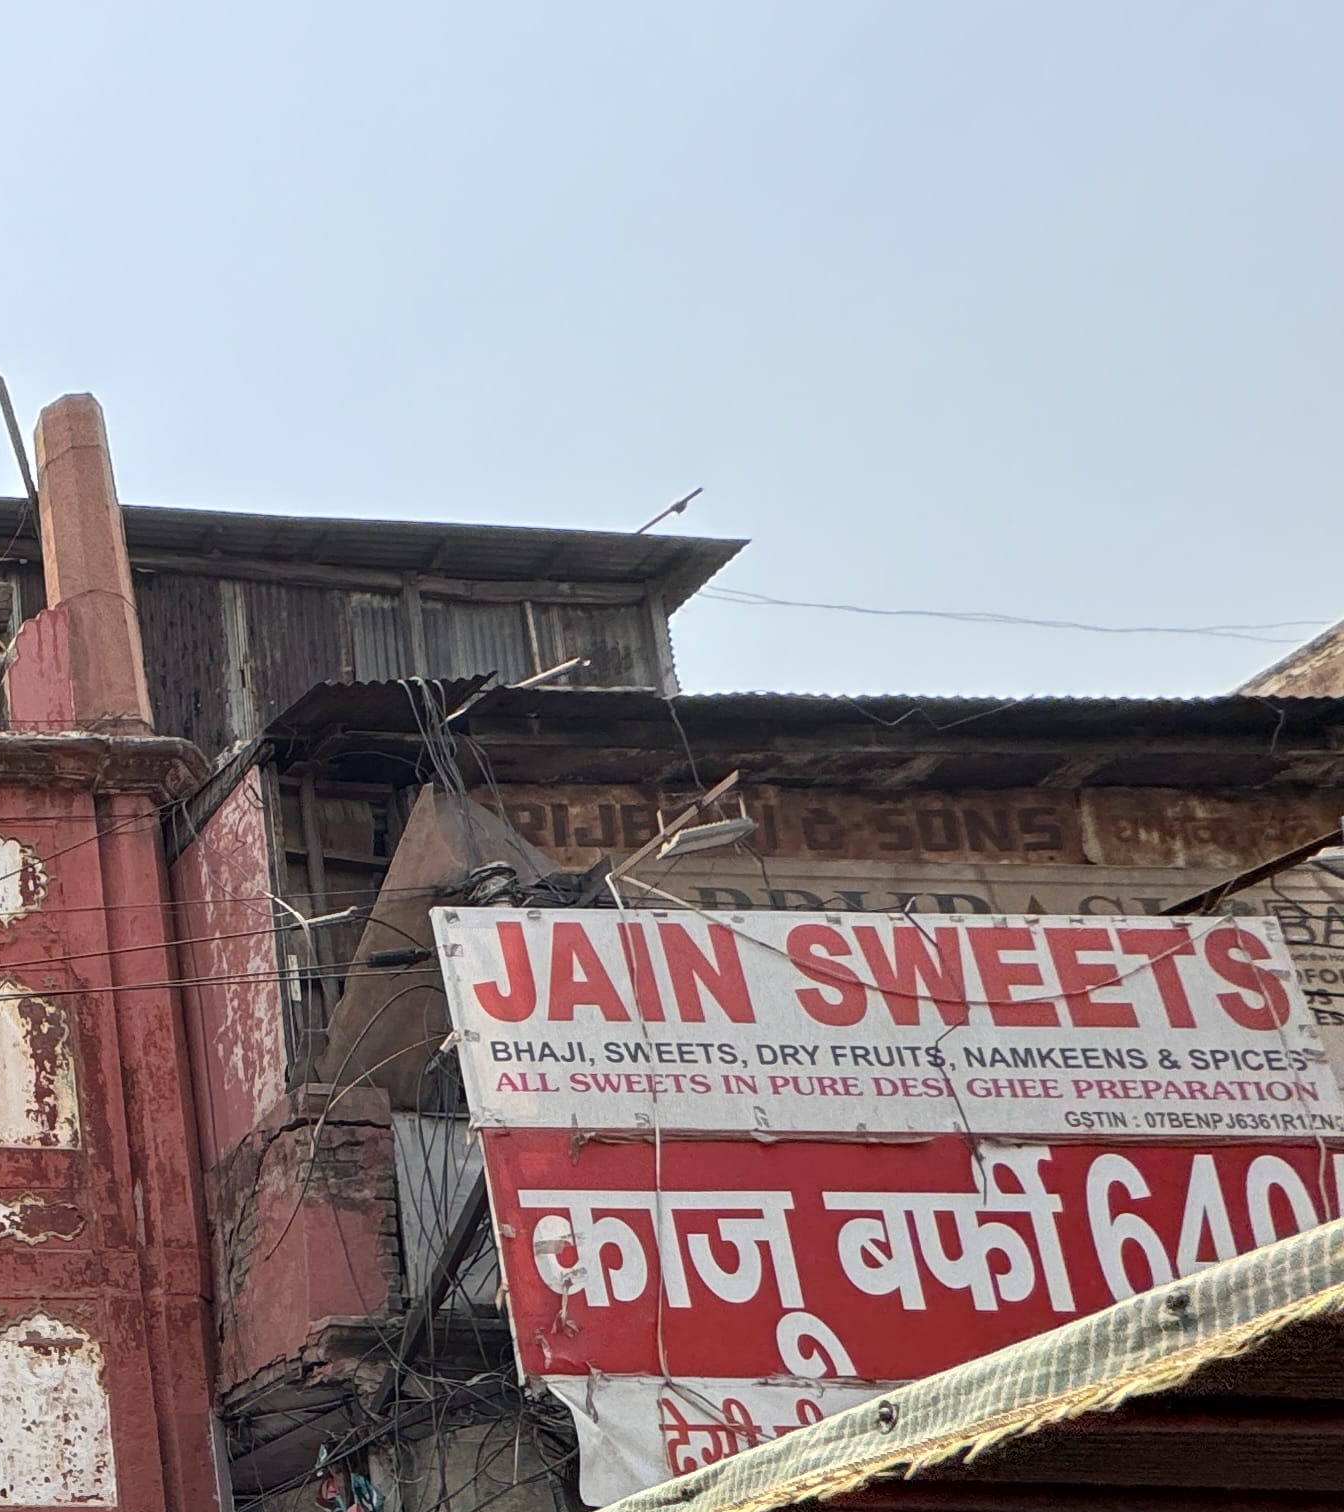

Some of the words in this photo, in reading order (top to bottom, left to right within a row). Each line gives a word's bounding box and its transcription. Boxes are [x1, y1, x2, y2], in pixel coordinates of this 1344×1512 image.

[871, 805, 1063, 852] SONS
[472, 920, 757, 1025] JAIN
[787, 923, 1291, 1032] SWEETS
[490, 1040, 596, 1067] BHAJI,
[605, 1041, 750, 1069] SWEETS,
[755, 1044, 818, 1067] DRY
[832, 1045, 956, 1072] FRUITS,
[963, 1047, 1150, 1071] NAMKEENS
[1158, 1048, 1182, 1070] &
[1190, 1048, 1309, 1072] SPICES
[495, 1072, 560, 1093] ALL
[569, 1073, 712, 1095] SWEETS
[723, 1075, 759, 1095] IN
[768, 1075, 865, 1097] PURE
[873, 1076, 954, 1098] DESI
[966, 1077, 1065, 1099] GHEE
[1074, 1078, 1321, 1102] PREPARATION
[1064, 1110, 1128, 1128] GSTIN
[518, 1189, 859, 1377] काजू
[822, 1145, 1077, 1314] बर्फी
[1087, 1153, 1344, 1302] 640
